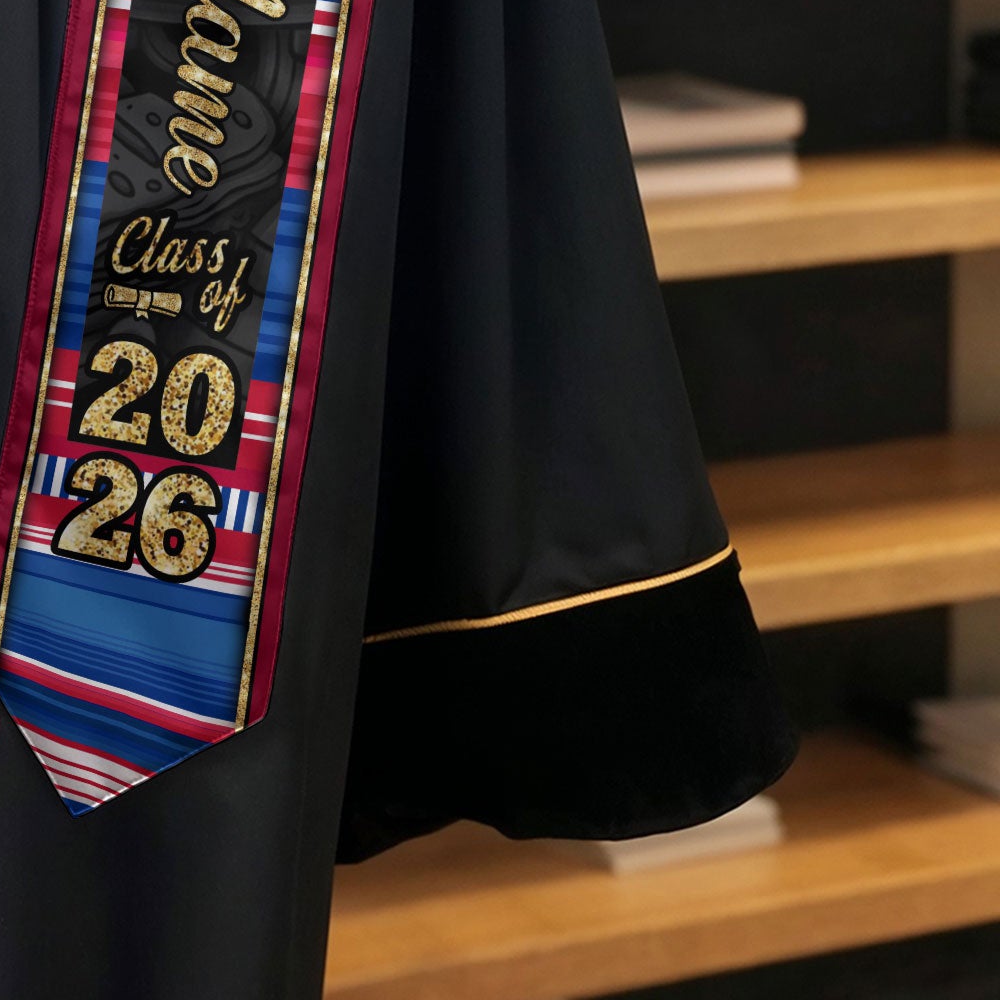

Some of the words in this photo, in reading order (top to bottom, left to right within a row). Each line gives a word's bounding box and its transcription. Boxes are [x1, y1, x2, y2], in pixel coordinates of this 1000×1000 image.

[111, 215, 230, 275] Class
[199, 257, 249, 333] of
[78, 339, 236, 456] 20
[56, 457, 217, 577] 26
